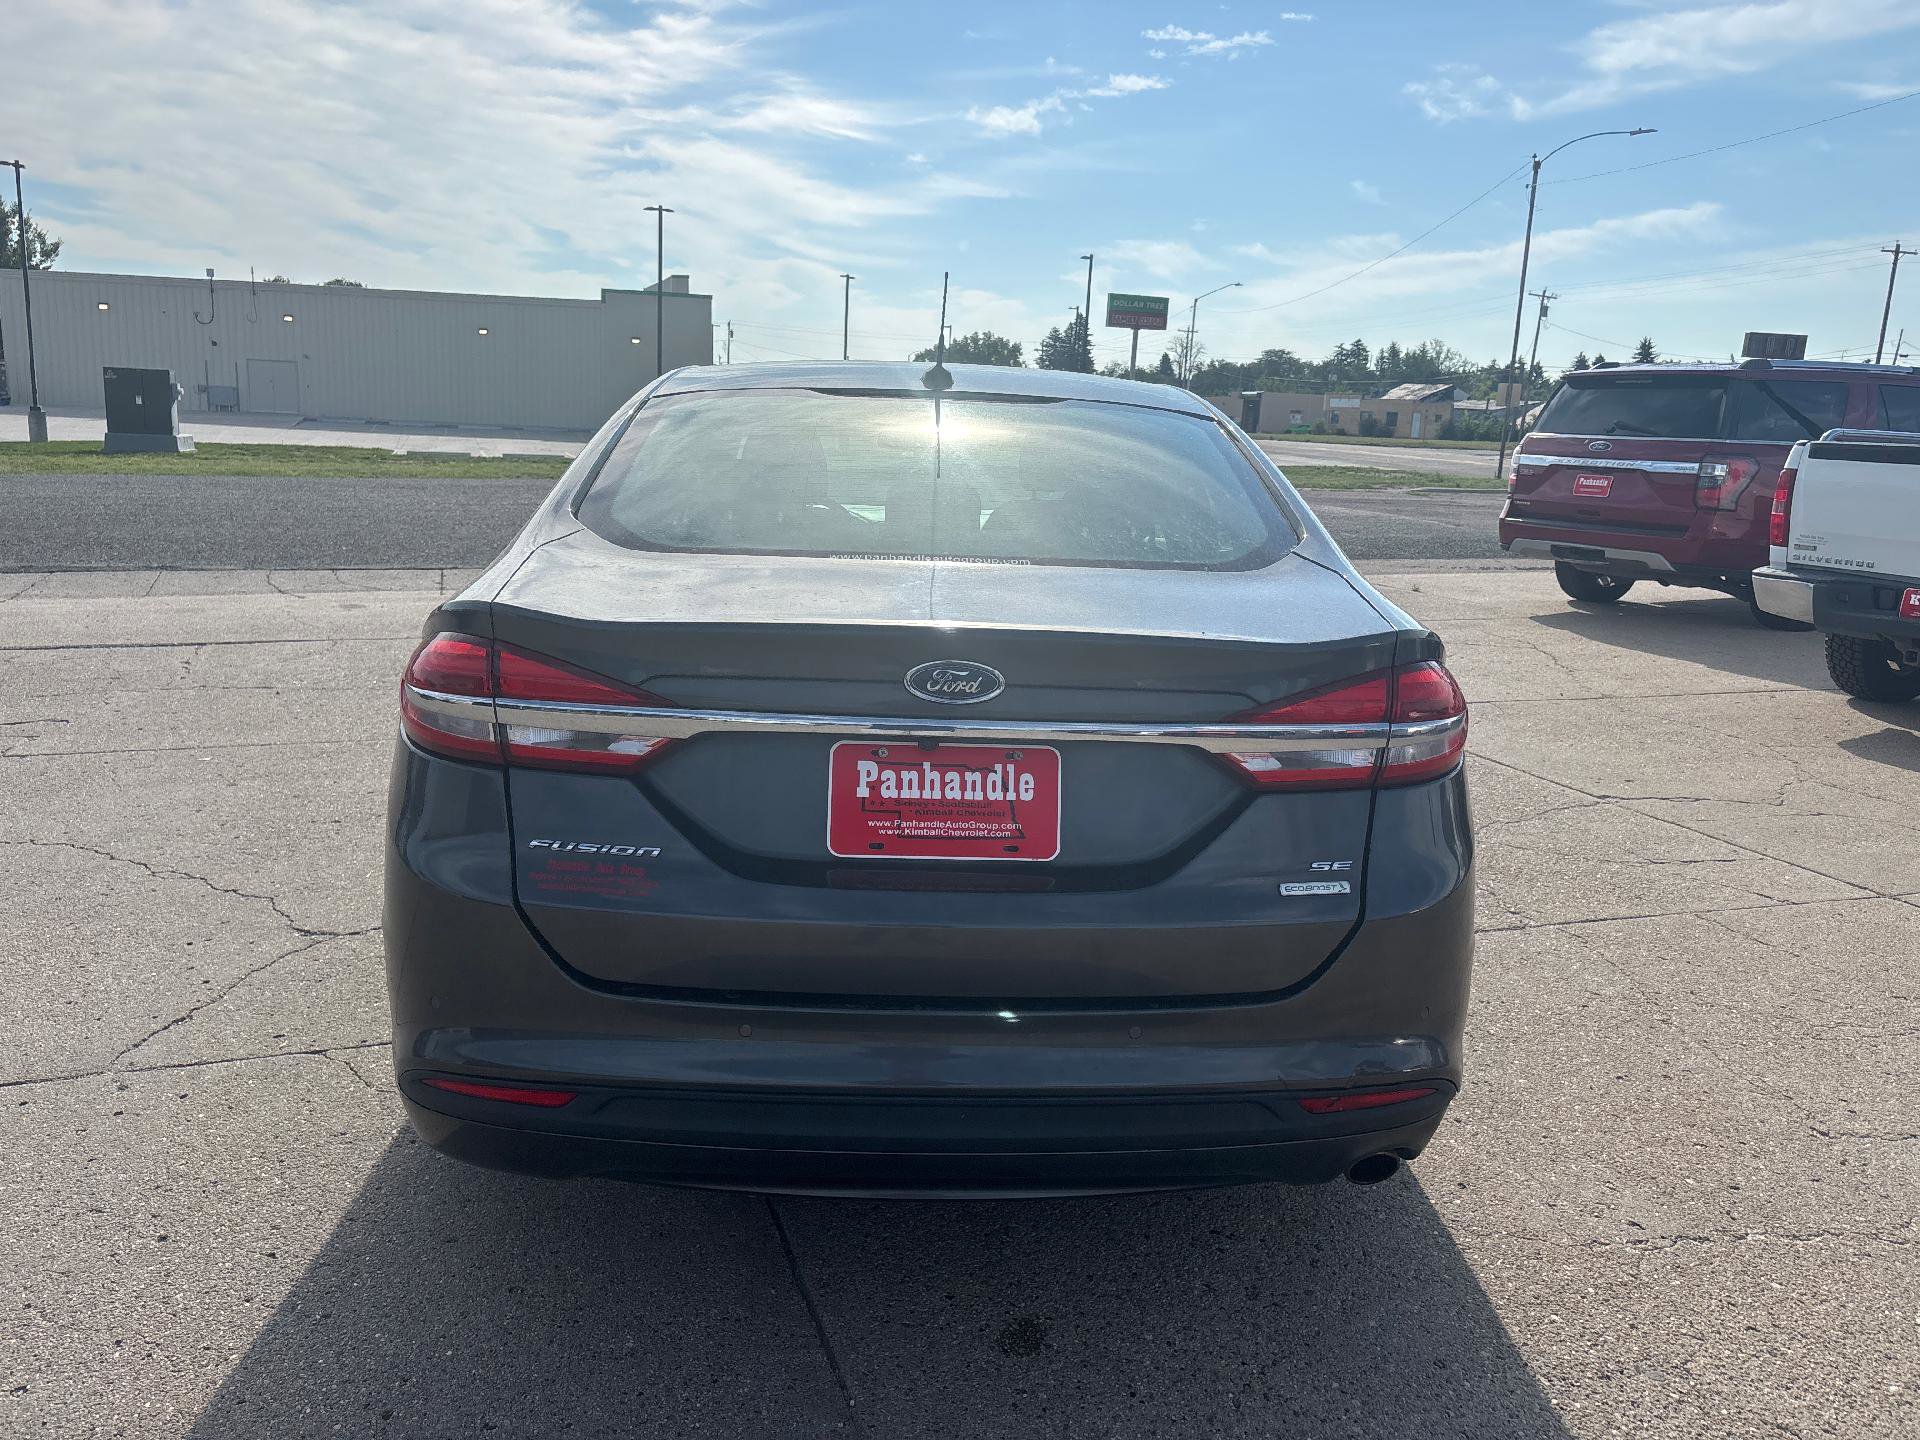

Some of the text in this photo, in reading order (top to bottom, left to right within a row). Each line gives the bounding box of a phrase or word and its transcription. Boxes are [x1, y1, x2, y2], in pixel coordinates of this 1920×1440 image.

[1113, 300, 1165, 310] DOLLAR TREE
[1793, 554, 1875, 568] SILVERADO
[926, 669, 983, 693] Ford
[856, 760, 1035, 801] Panhandle
[867, 819, 1022, 831] www.PanhandleAutoGroup.com
[878, 828, 1011, 838] www.KimballChevrolet.com
[528, 838, 662, 857] FUSION
[1308, 860, 1353, 871] SE
